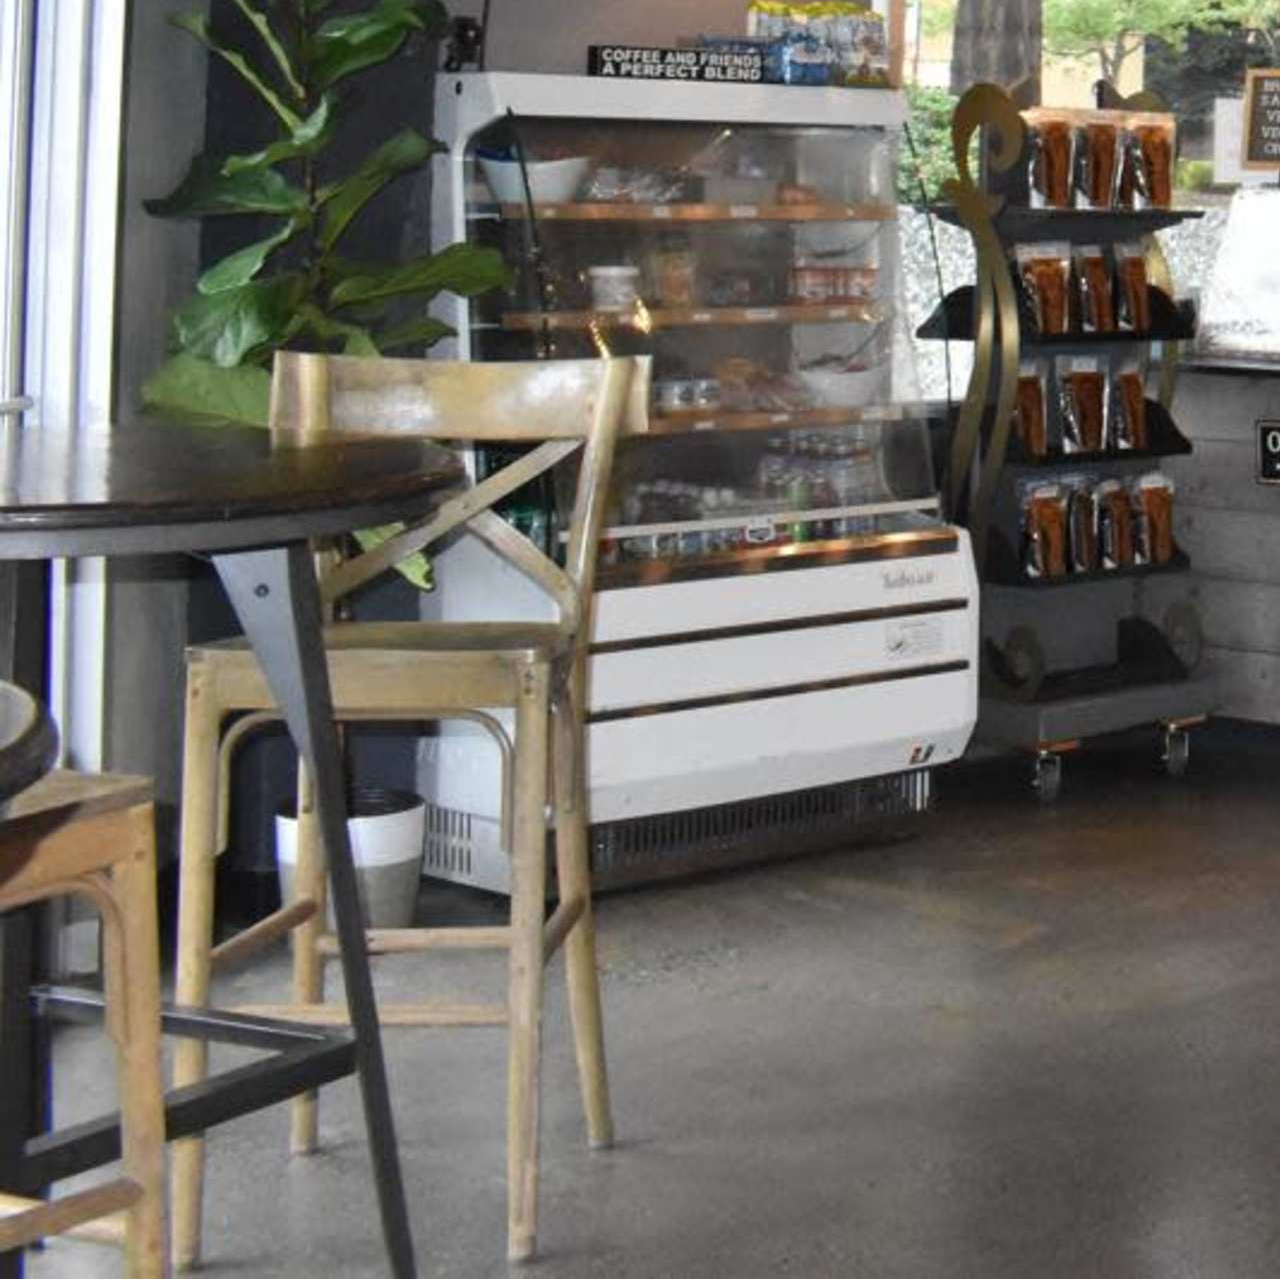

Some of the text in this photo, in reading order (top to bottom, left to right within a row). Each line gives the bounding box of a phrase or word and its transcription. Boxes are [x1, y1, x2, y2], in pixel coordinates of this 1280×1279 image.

[602, 48, 661, 64] COFFEE
[664, 50, 697, 66] AND
[700, 52, 762, 68] FRIENDS
[602, 62, 761, 81] A PERFECT BLEND
